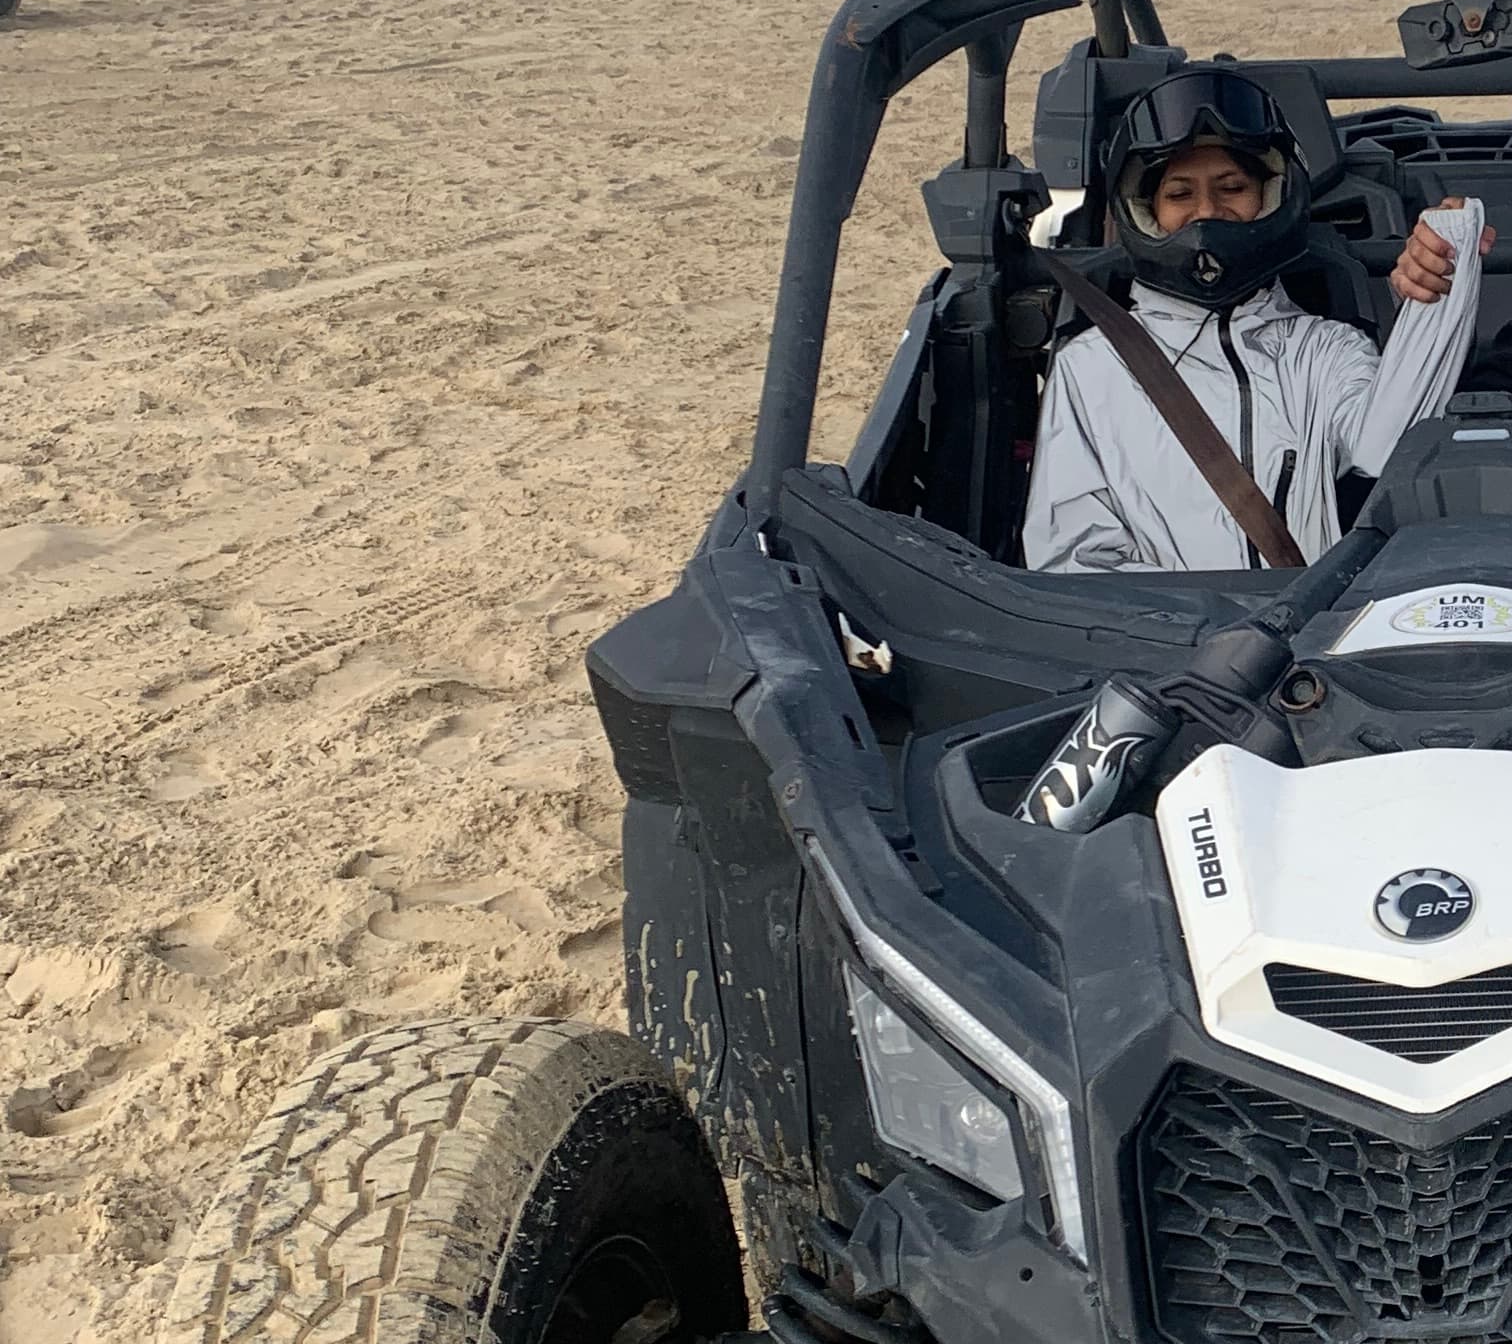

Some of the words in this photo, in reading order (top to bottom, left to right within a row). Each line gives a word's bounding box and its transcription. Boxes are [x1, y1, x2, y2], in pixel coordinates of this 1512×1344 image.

[1439, 595, 1485, 605] UM
[1434, 620, 1484, 628] 401
[1188, 808, 1227, 899] TURBO
[1415, 900, 1470, 917] BRP
